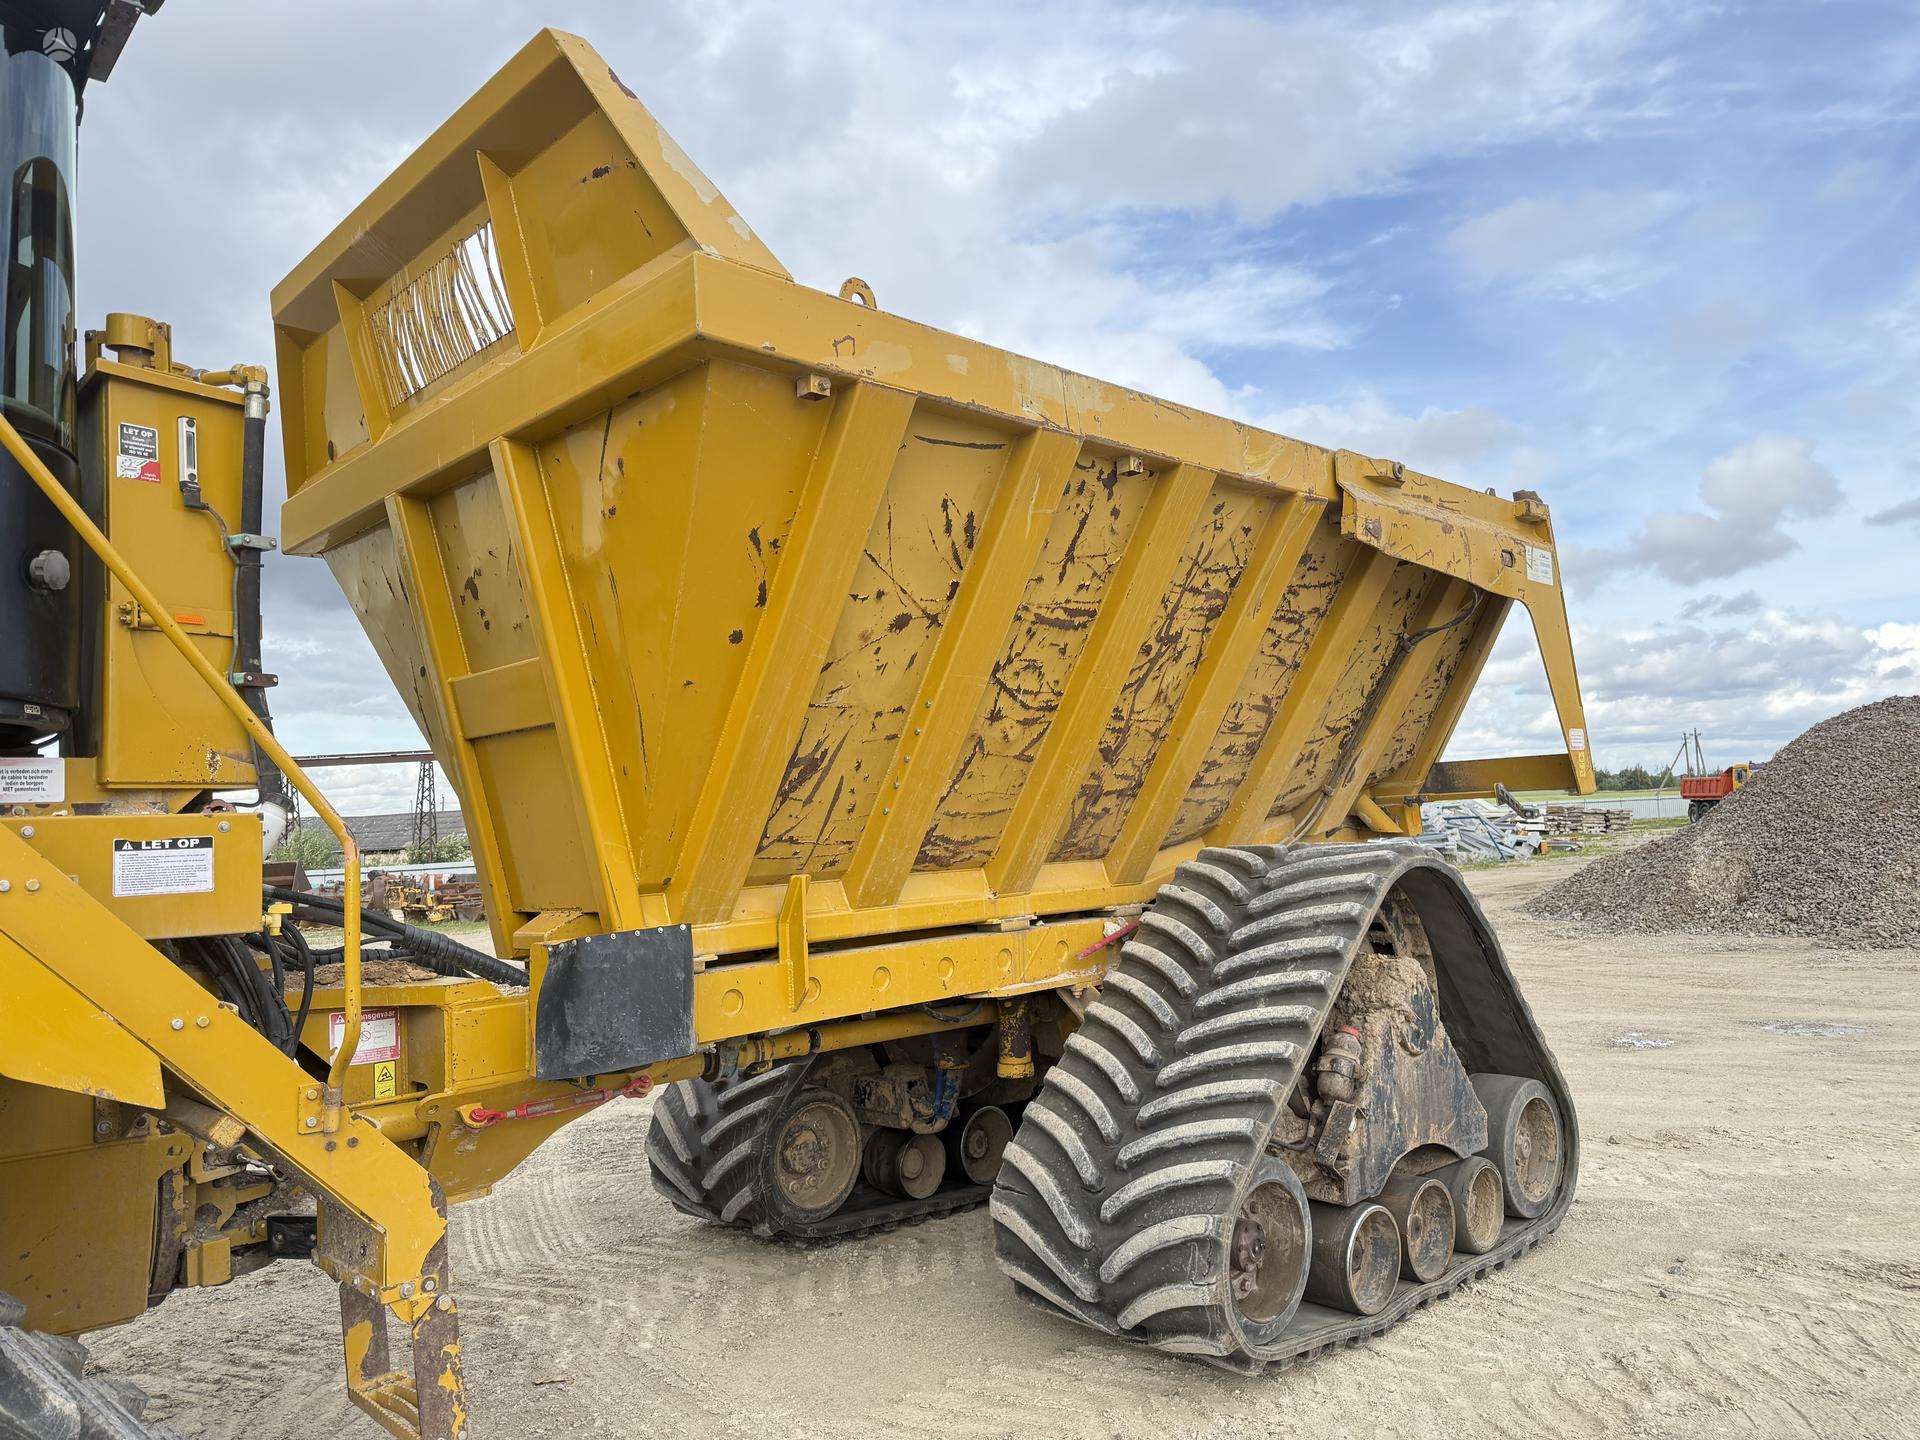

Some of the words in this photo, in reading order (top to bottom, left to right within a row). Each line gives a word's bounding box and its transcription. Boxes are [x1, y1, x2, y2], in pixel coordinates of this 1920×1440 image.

[123, 427, 139, 435] LET
[141, 430, 153, 438] OP
[141, 839, 173, 850] LET
[177, 838, 200, 848] OP
